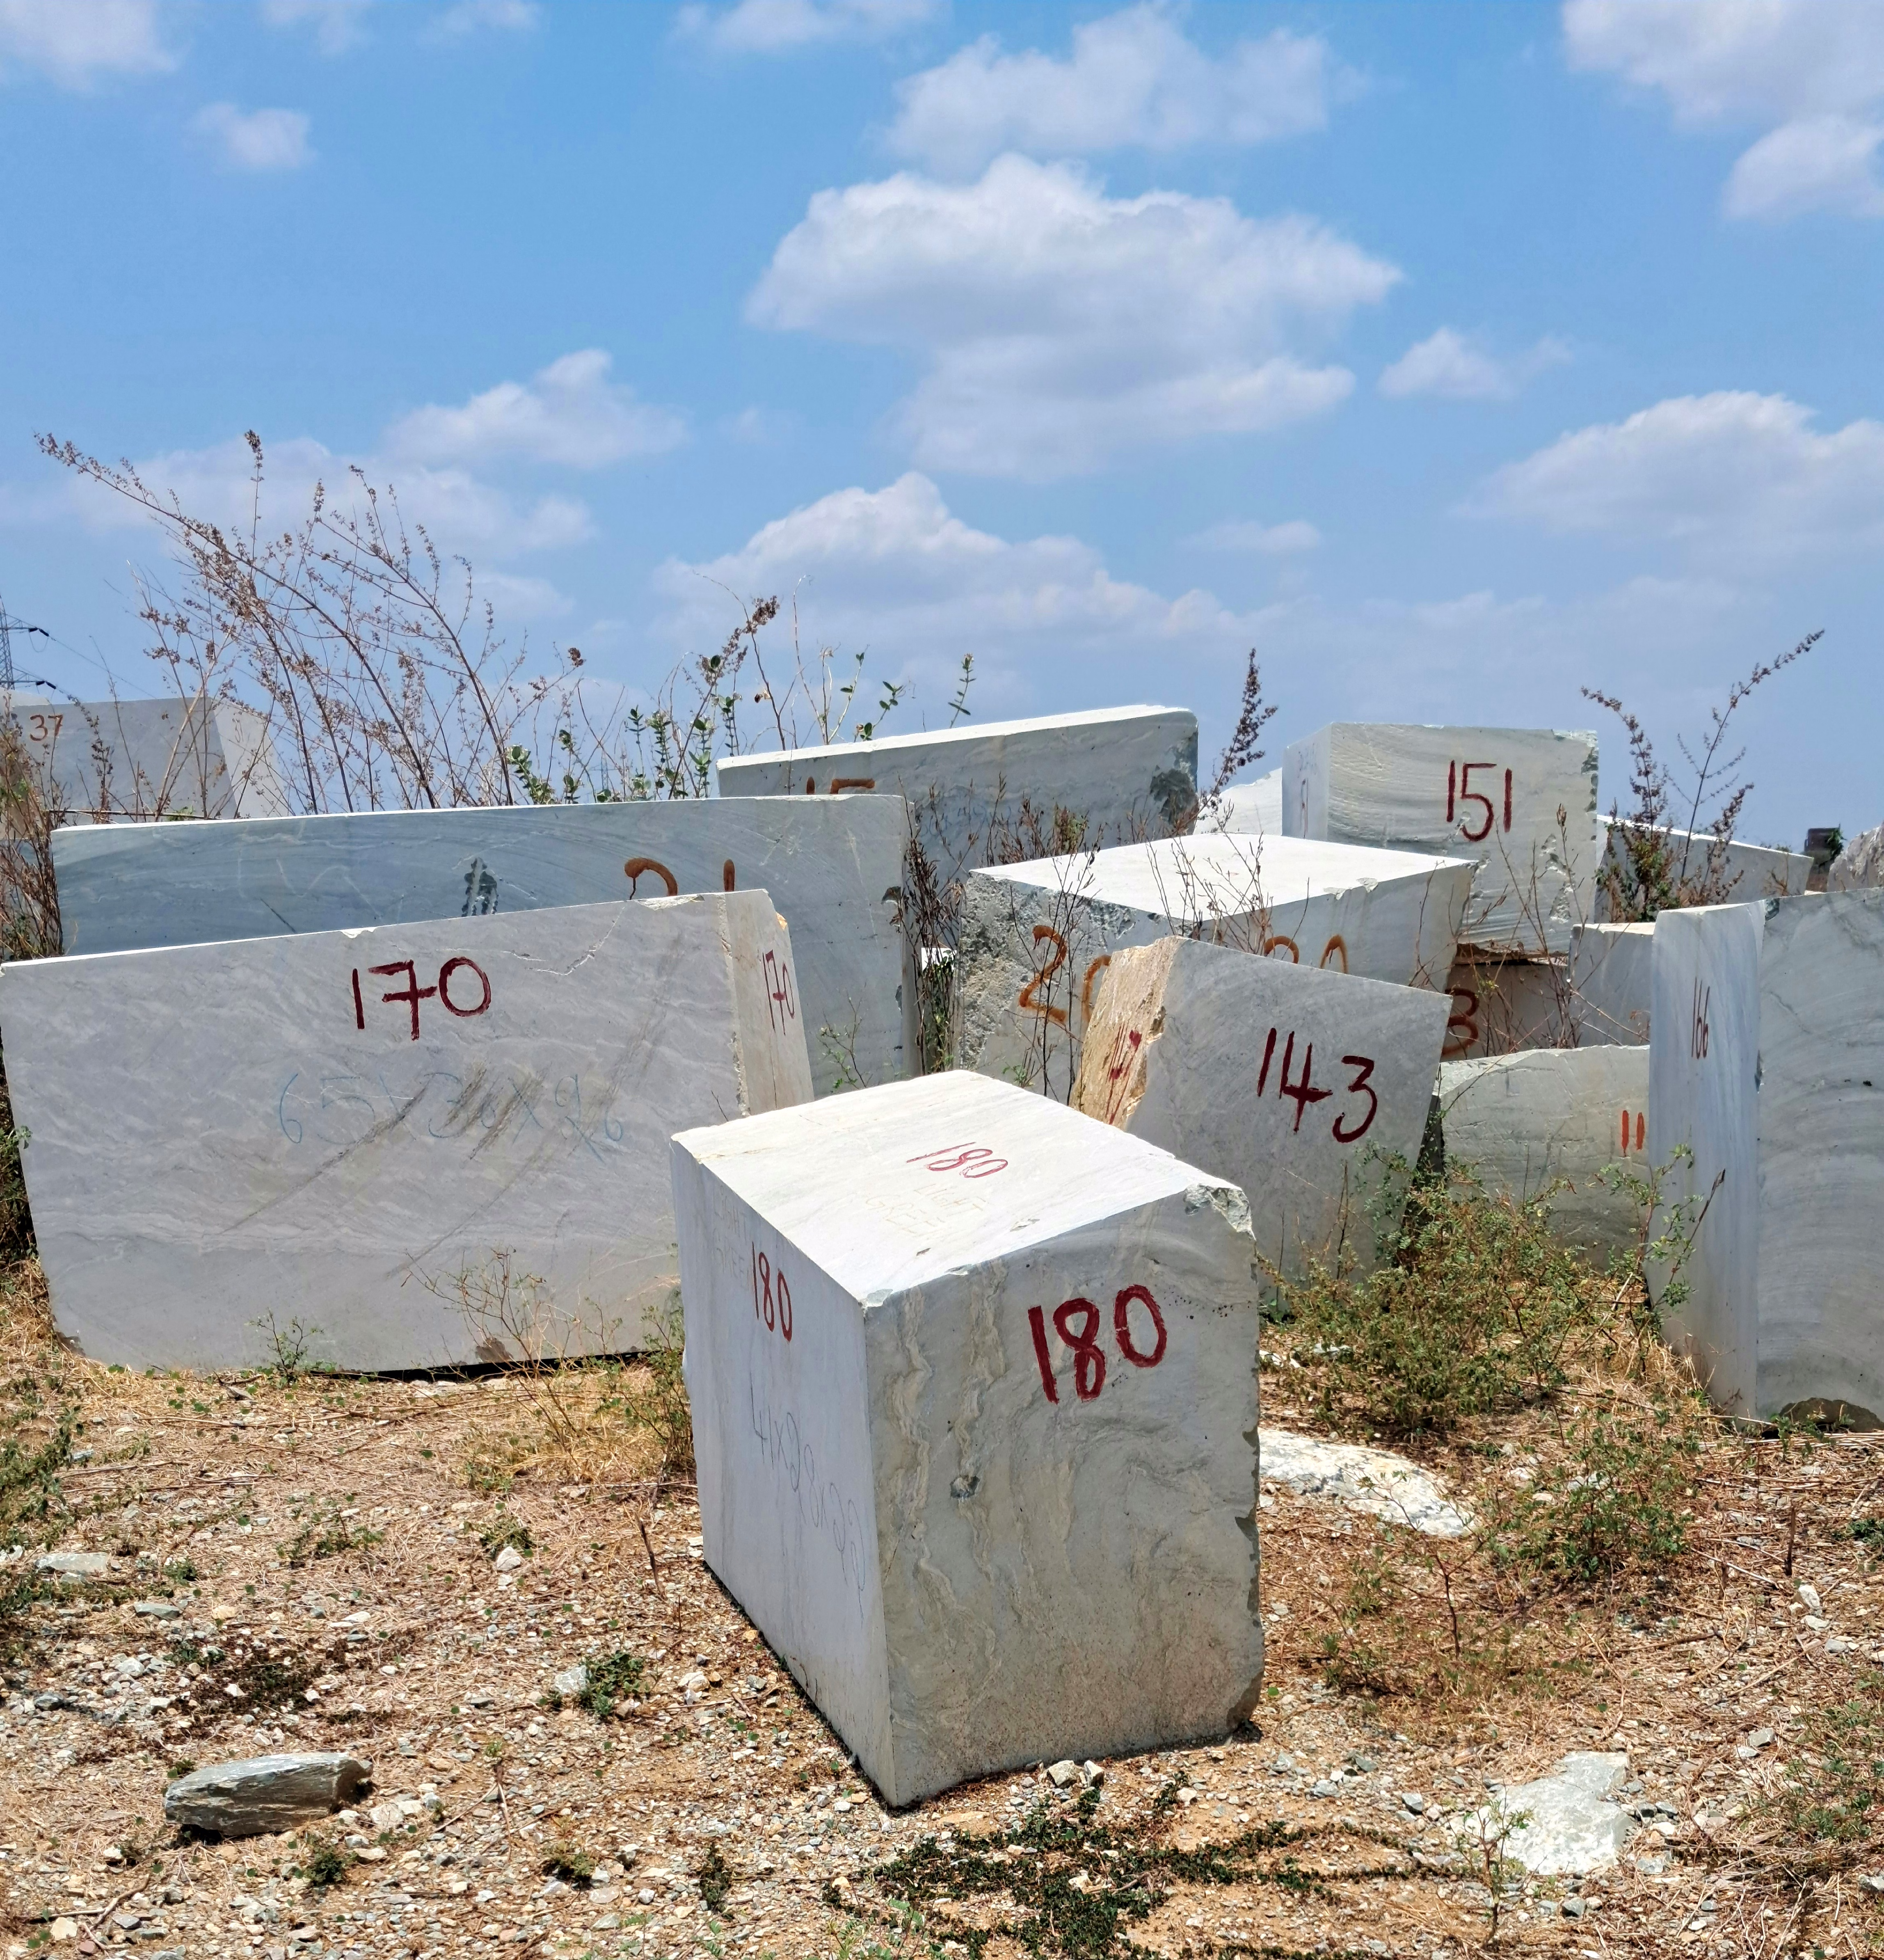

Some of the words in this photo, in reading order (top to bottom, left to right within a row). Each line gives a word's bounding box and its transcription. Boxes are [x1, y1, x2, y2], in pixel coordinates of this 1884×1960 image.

[30, 714, 63, 742] 37
[1446, 760, 1513, 842] 151
[352, 956, 492, 1041] 170
[762, 949, 795, 1037] 170
[1691, 976, 1711, 1059] 166
[1257, 1027, 1378, 1143] 143
[906, 1141, 1009, 1179] 180
[752, 1240, 792, 1342] 180
[1027, 1284, 1167, 1405] 180
